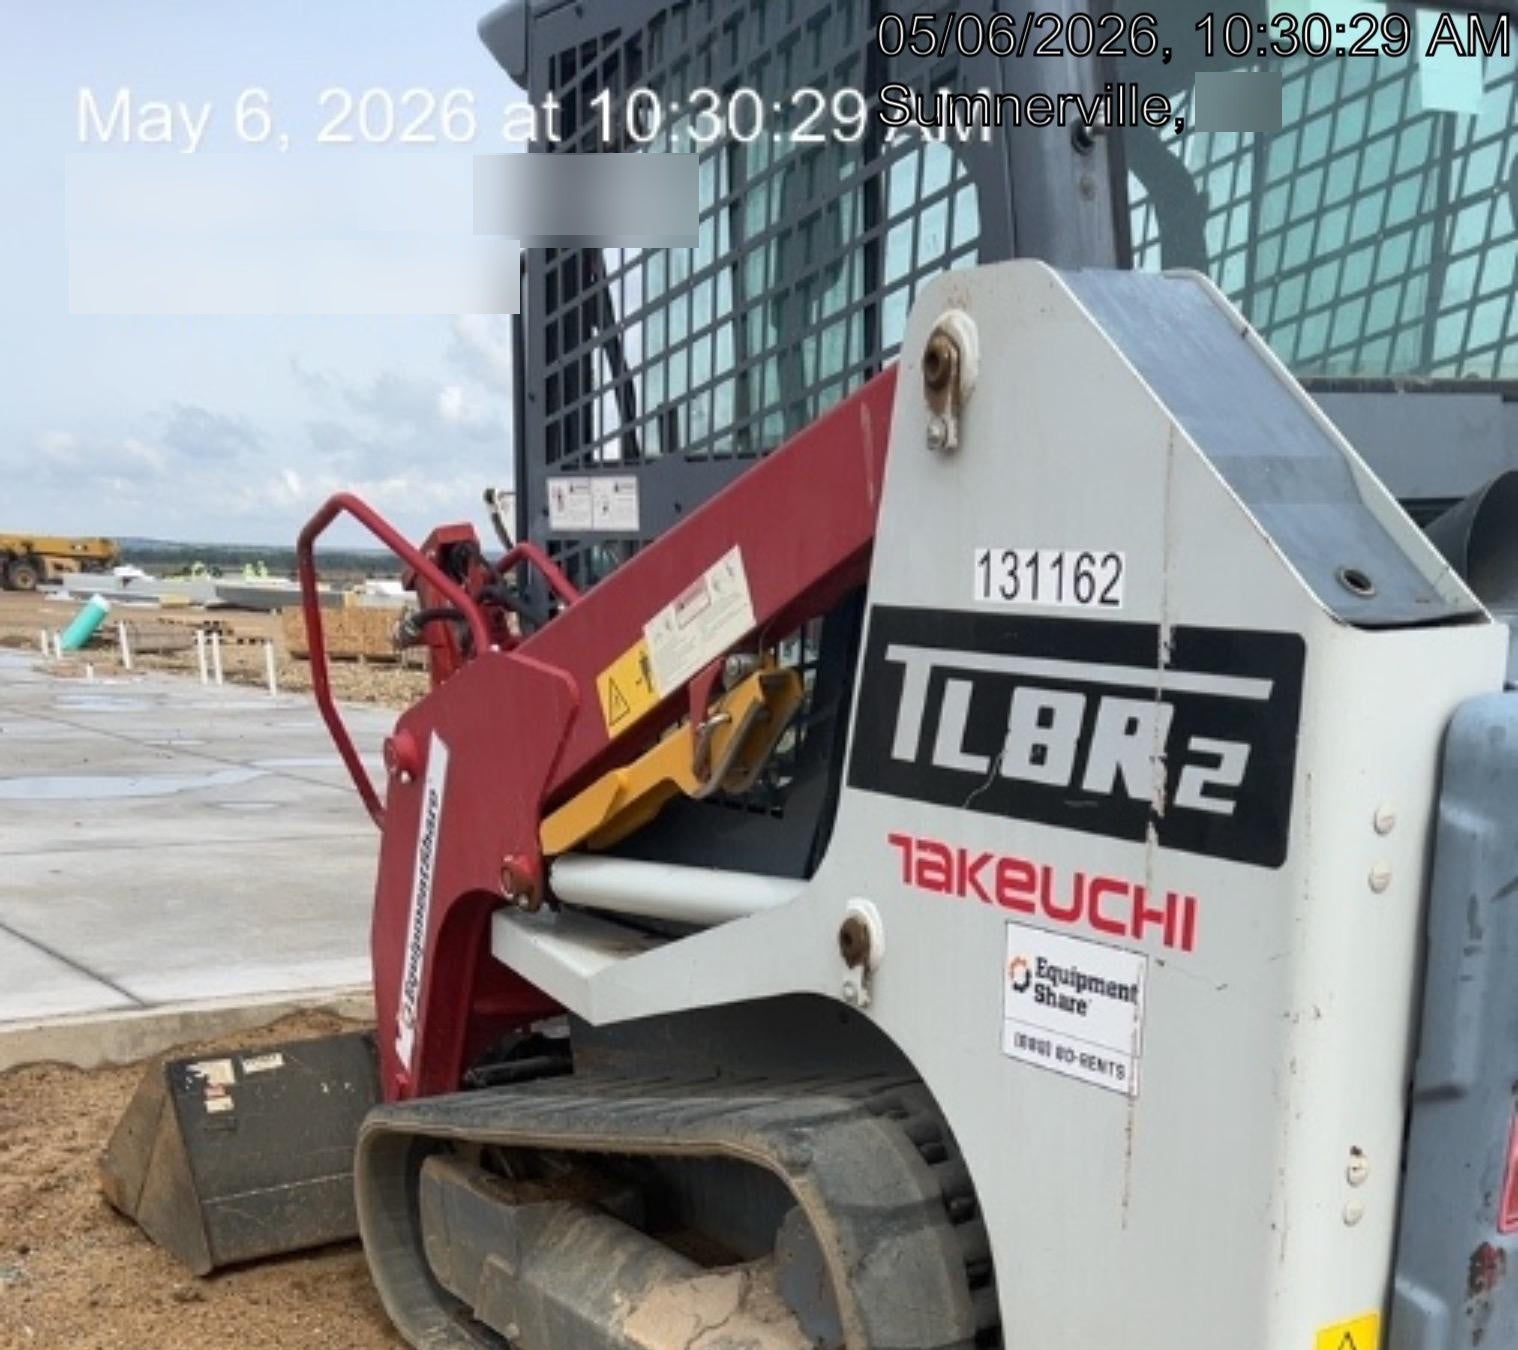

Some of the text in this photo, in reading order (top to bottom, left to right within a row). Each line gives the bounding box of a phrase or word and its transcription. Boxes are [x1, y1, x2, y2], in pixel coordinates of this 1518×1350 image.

[977, 550, 1123, 606] 131162
[1033, 982, 1088, 1017] Share
[1034, 956, 1139, 1002] Equipment
